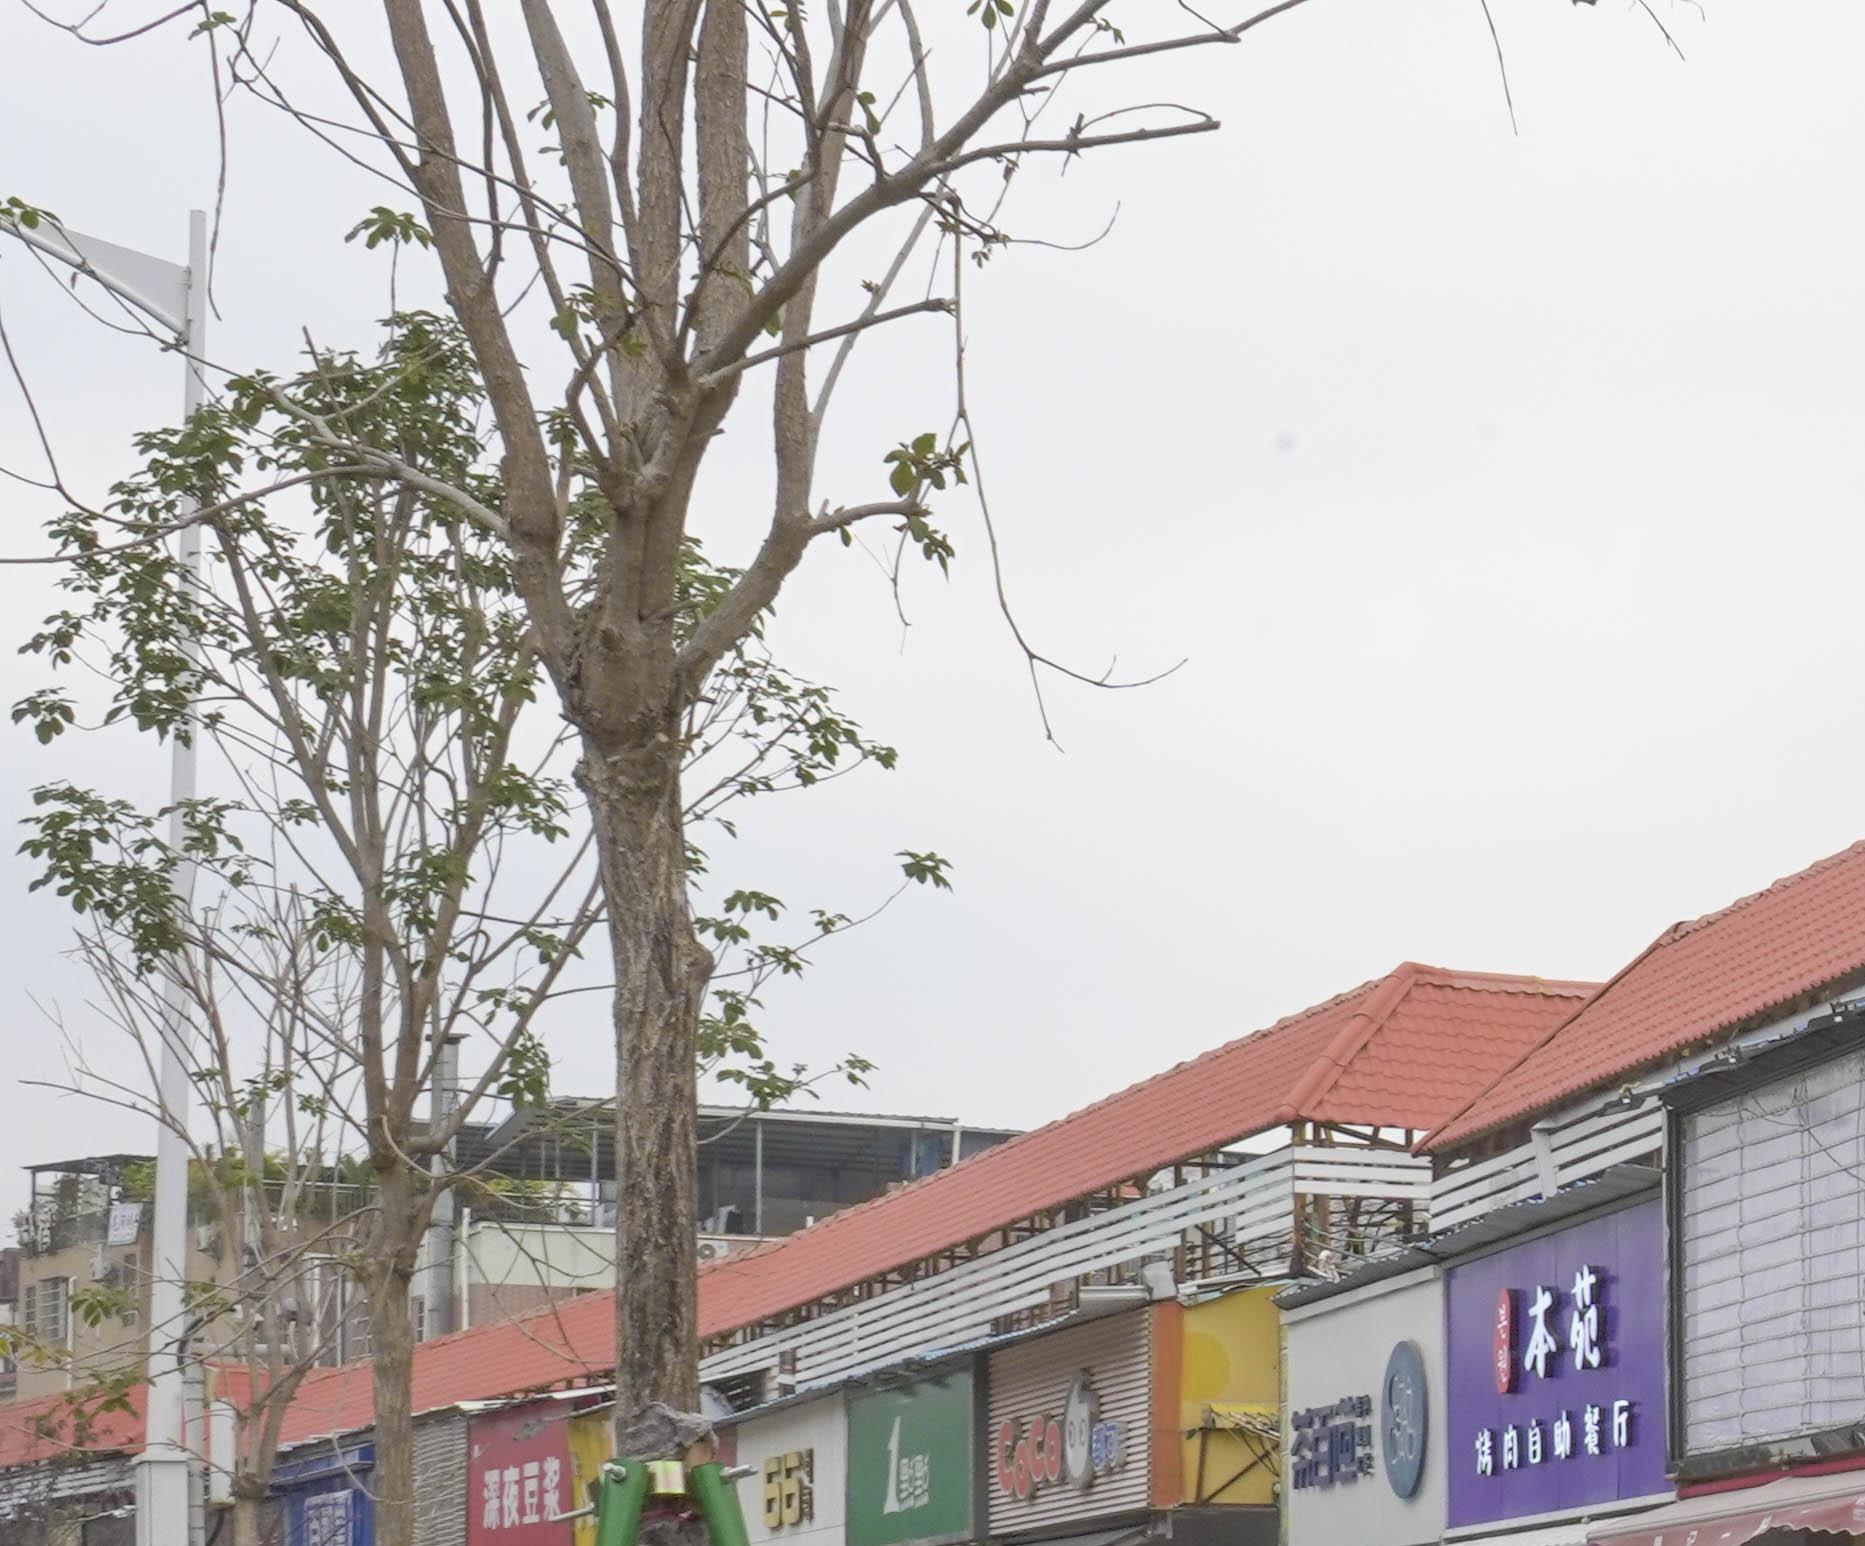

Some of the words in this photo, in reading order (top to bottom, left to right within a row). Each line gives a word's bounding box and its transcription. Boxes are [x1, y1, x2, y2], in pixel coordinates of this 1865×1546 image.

[1523, 1264, 1602, 1379] 本苑
[1475, 1400, 1630, 1477] 烤肉自助餐厅
[482, 1456, 563, 1531] 深夜豆浆
